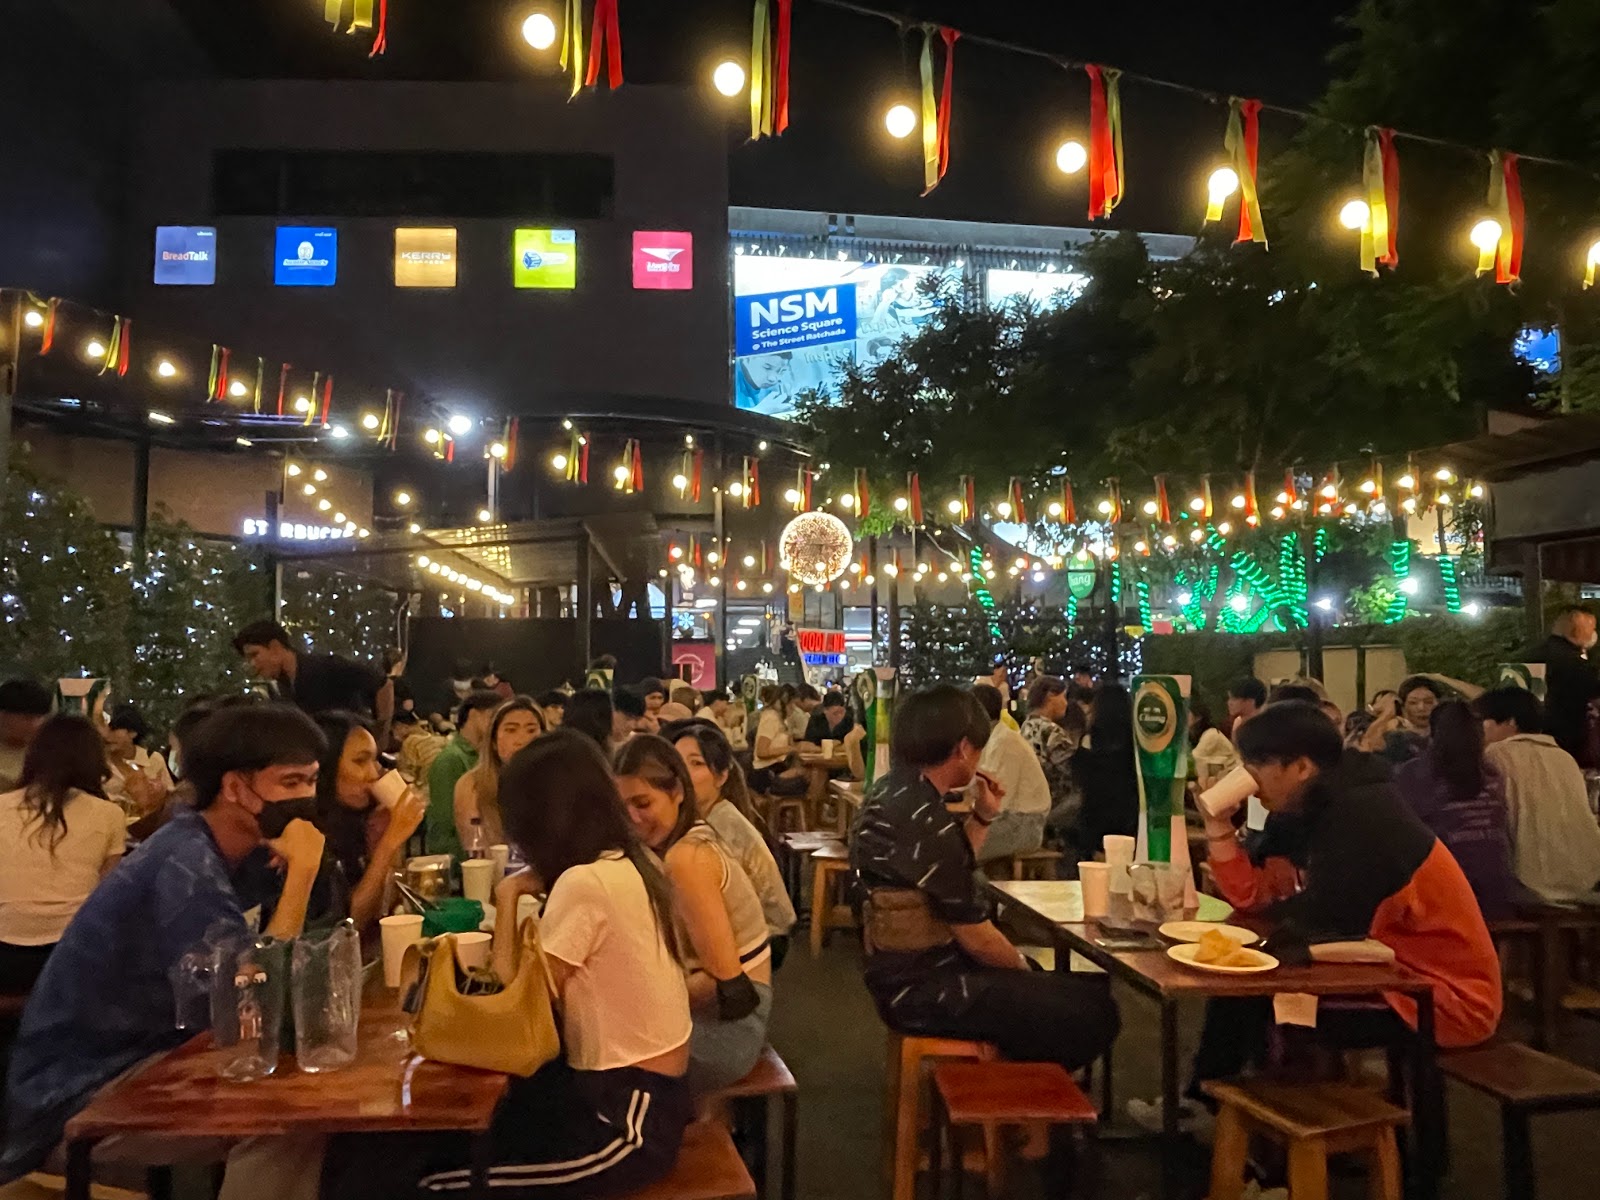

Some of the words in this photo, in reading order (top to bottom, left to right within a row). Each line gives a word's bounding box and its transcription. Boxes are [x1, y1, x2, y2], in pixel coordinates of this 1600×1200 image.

[162, 251, 209, 261] BreadTalk
[750, 287, 838, 328] NSM
[752, 325, 799, 340] Science
[801, 317, 843, 332] Square
[761, 338, 778, 349] The
[779, 334, 805, 346] Street
[806, 328, 846, 341] Ratchada
